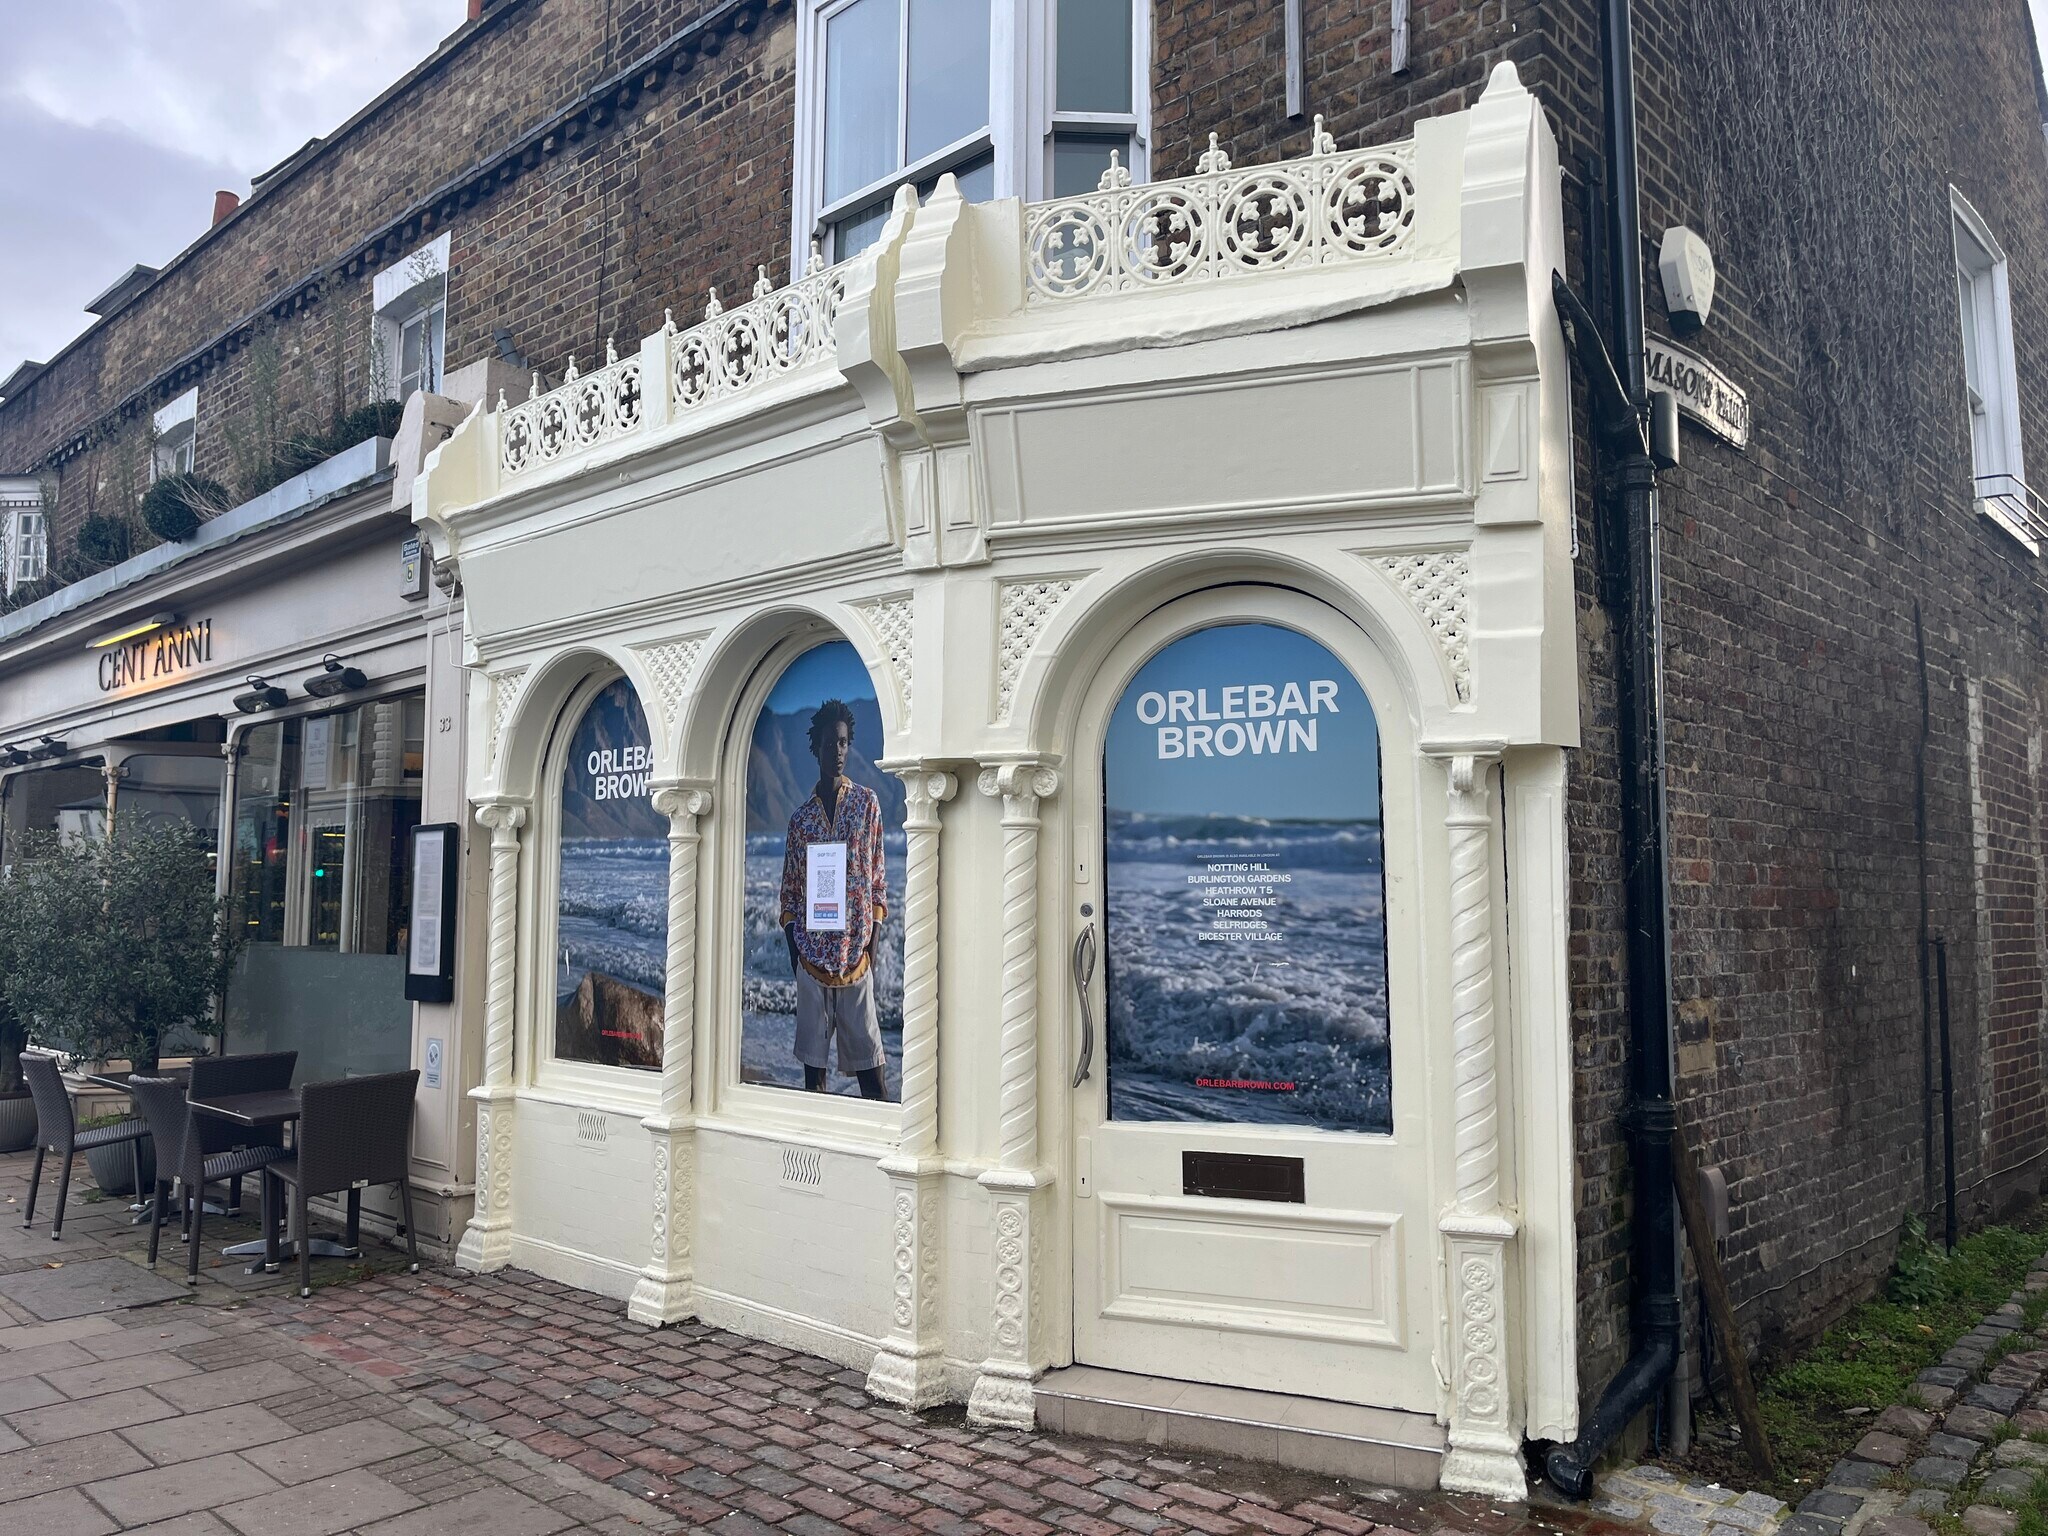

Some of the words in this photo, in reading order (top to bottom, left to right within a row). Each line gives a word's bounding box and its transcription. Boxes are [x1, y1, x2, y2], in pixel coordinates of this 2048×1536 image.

[98, 639, 150, 692] CENT
[153, 618, 212, 677] ANNI
[1136, 679, 1340, 725] ORLEBAR
[1158, 718, 1318, 760] BROWN
[1207, 863, 1248, 872] NOTTING
[1250, 863, 1270, 871] HILL
[1187, 875, 1245, 884] BURLINGTON
[1247, 874, 1292, 883] GARDENS
[1205, 886, 1257, 895] HEATHROW
[1259, 886, 1273, 894] T5
[1203, 898, 1238, 906] SLOANE
[1240, 898, 1277, 906] AVENUE
[1217, 909, 1262, 918] HARRODS
[1213, 921, 1268, 930] SELFRIDGES
[1198, 932, 1242, 941] BICESTER
[1244, 932, 1283, 941] VILLAGE
[1195, 1078, 1295, 1091] ORLEBARBROWN.COM
